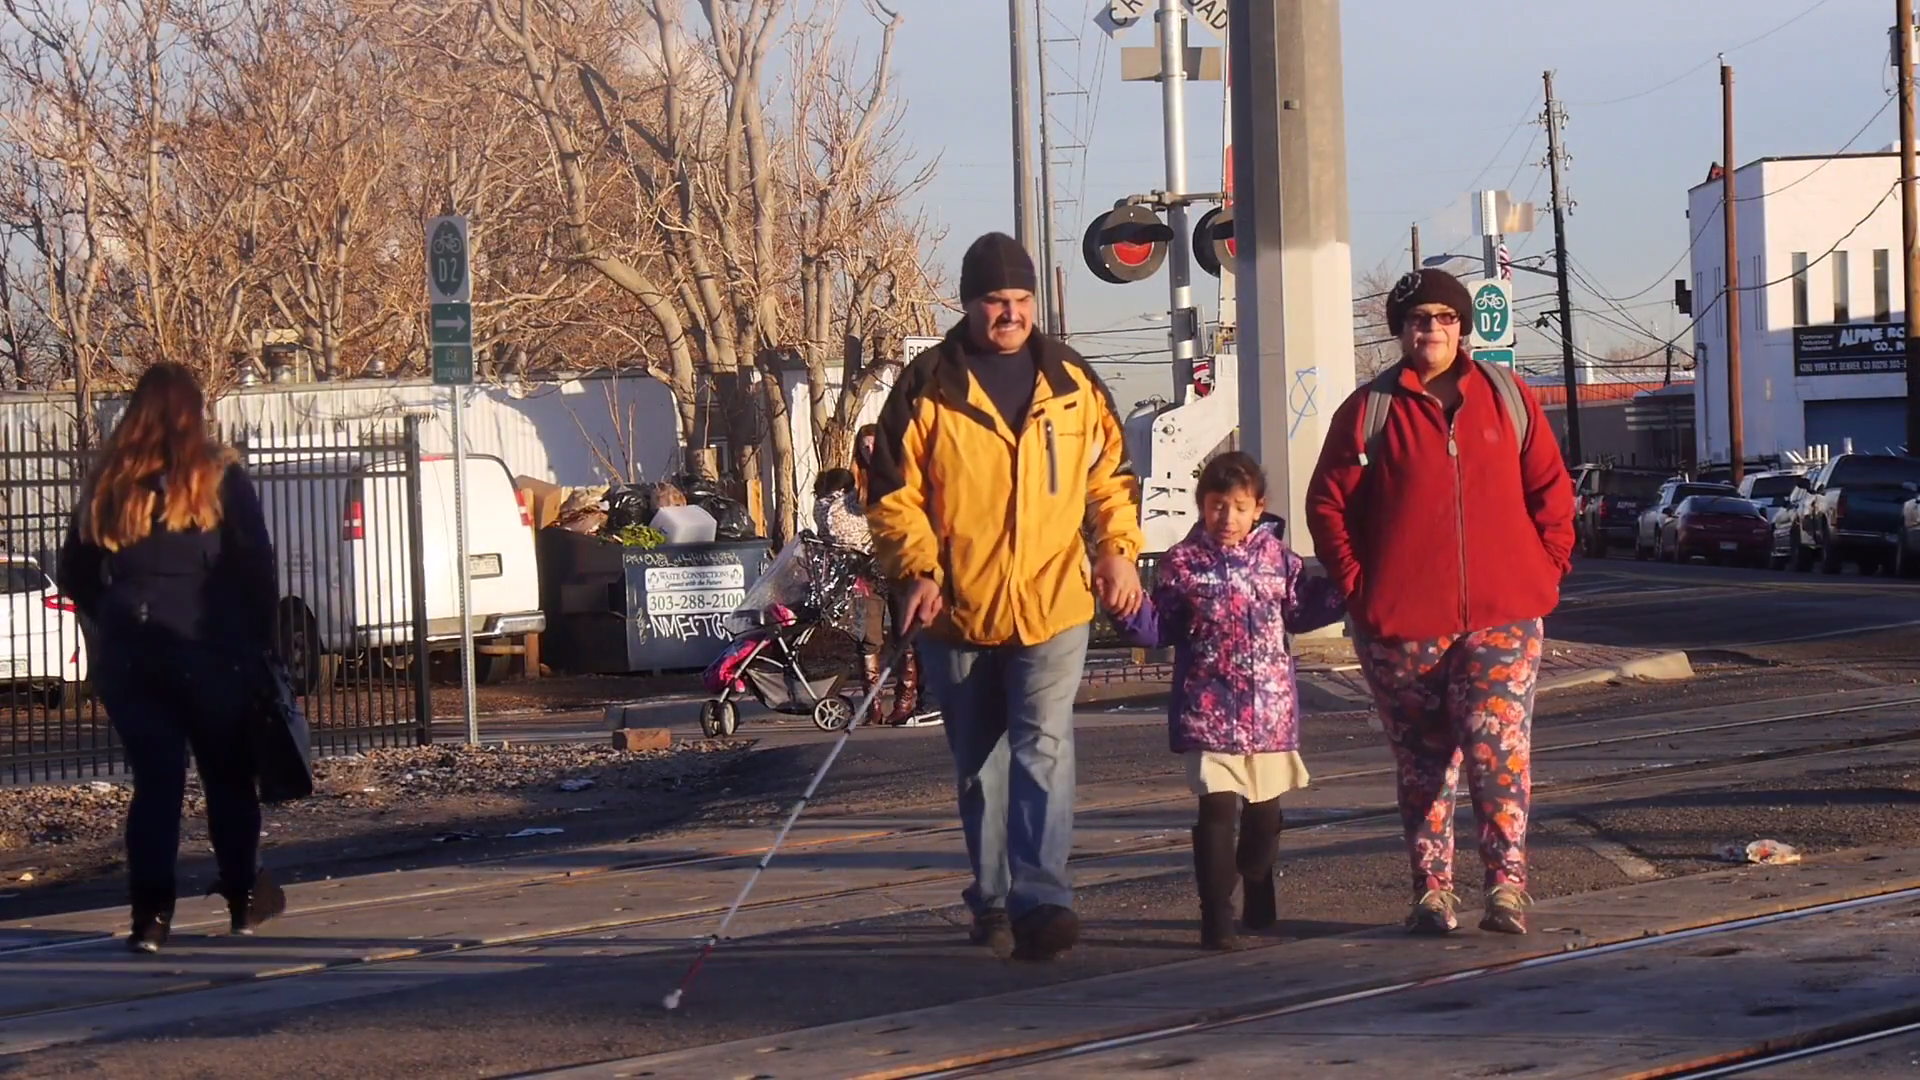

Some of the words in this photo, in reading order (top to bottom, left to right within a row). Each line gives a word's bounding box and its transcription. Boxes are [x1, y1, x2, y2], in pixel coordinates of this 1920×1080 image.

[438, 257, 459, 283] D2
[1480, 311, 1502, 333] D2
[1839, 328, 1883, 347] ALPINE
[437, 366, 469, 379] SIDEWALK
[659, 571, 680, 580] WASTE
[649, 592, 743, 611] 303-288-2100
